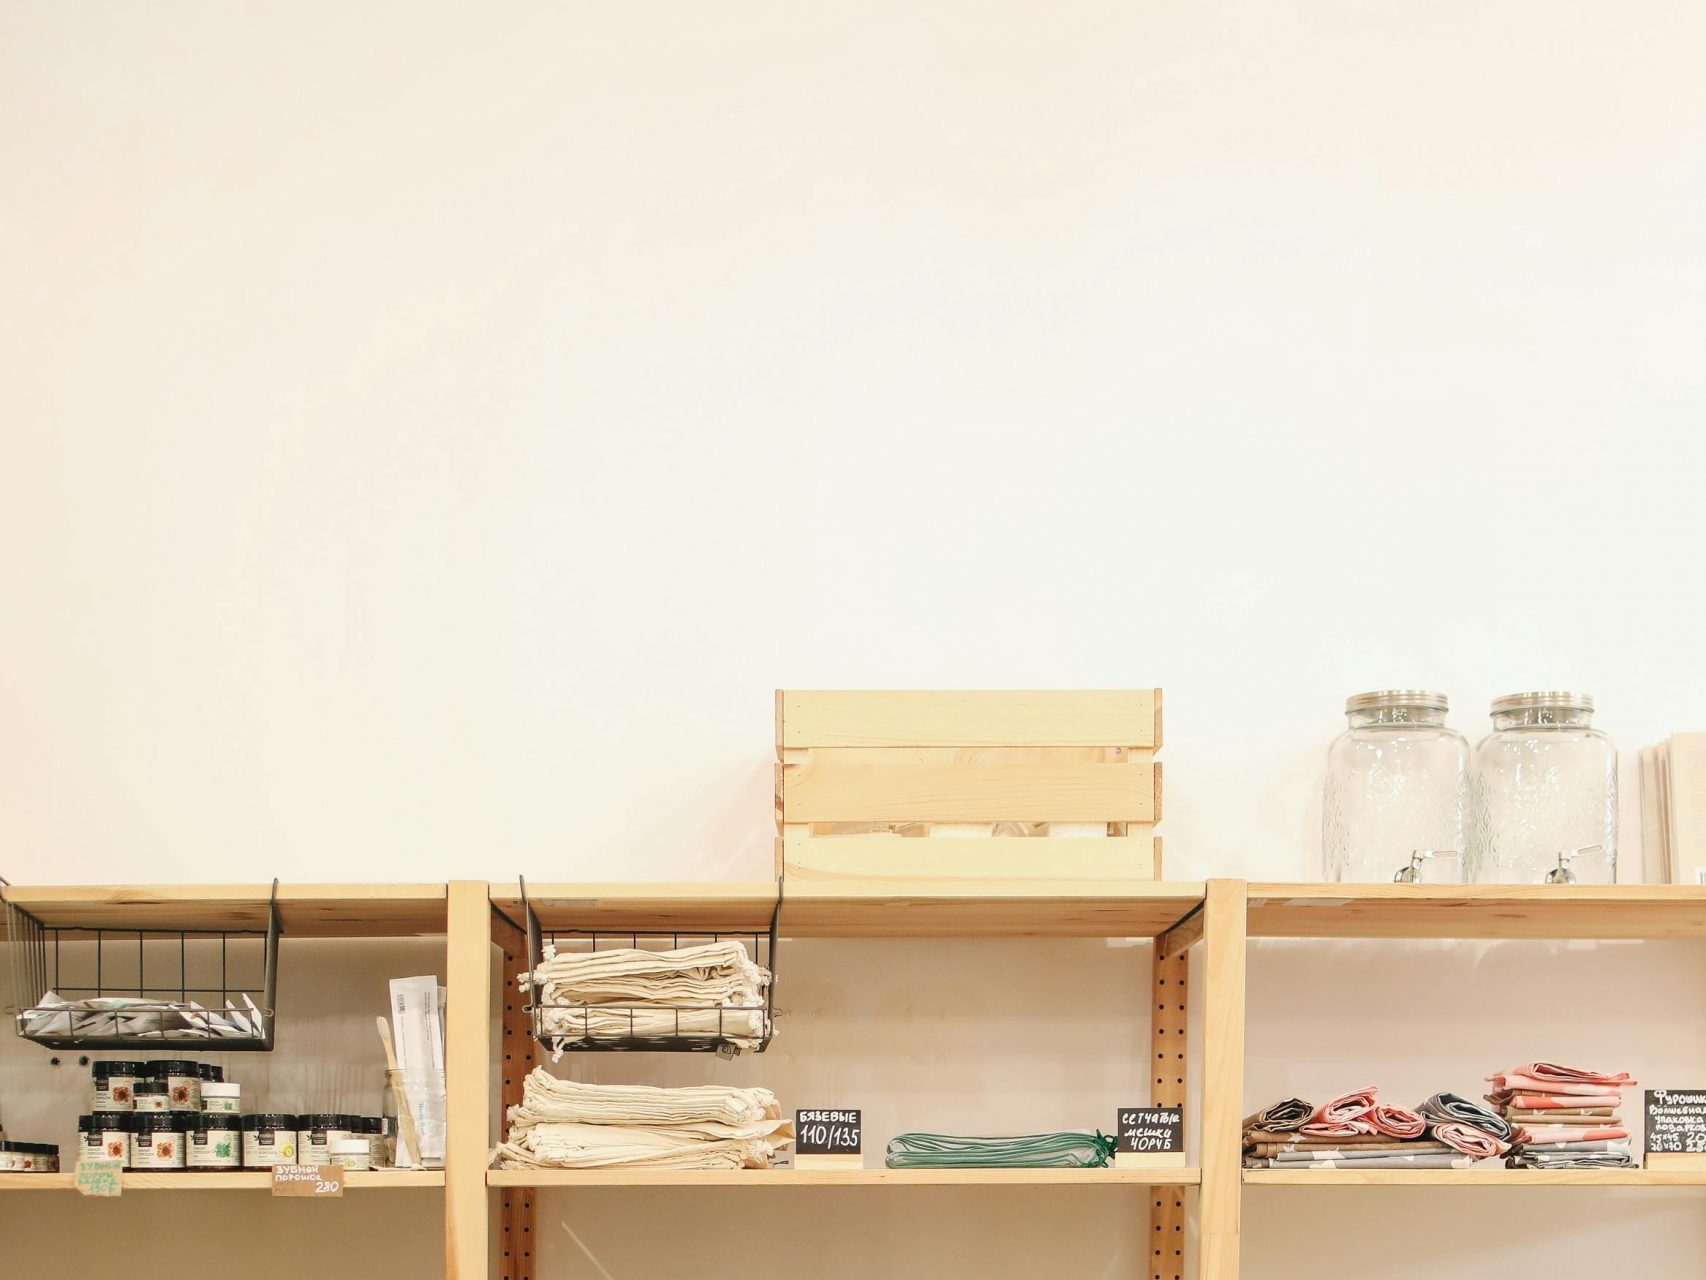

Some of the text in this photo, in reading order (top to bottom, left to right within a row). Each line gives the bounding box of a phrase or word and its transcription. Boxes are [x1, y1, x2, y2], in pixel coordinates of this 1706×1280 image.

[800, 1111, 857, 1123] БЯЗЕВЫЕ
[800, 1124, 860, 1149] 110/135
[315, 1181, 340, 1193] 280
